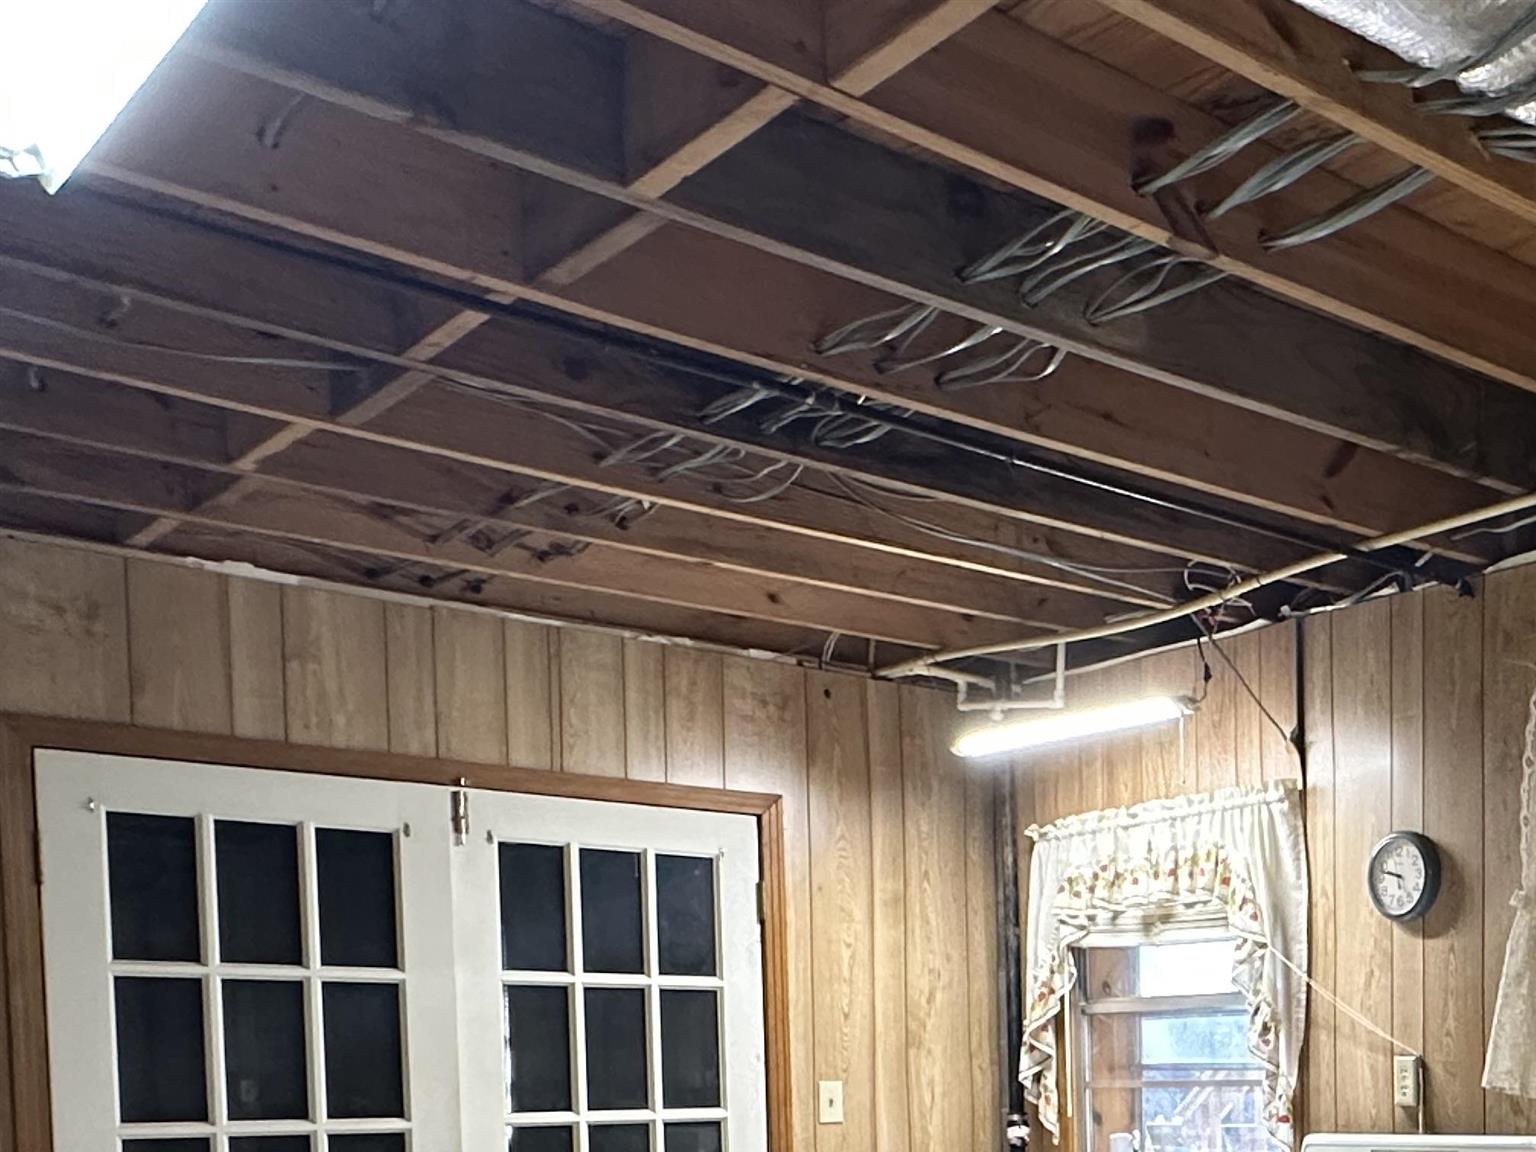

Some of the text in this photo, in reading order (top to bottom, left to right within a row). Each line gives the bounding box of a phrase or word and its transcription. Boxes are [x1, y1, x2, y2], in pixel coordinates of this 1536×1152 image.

[1411, 855, 1419, 866] 2
[1415, 868, 1422, 880] 3
[1389, 894, 1396, 906] 7
